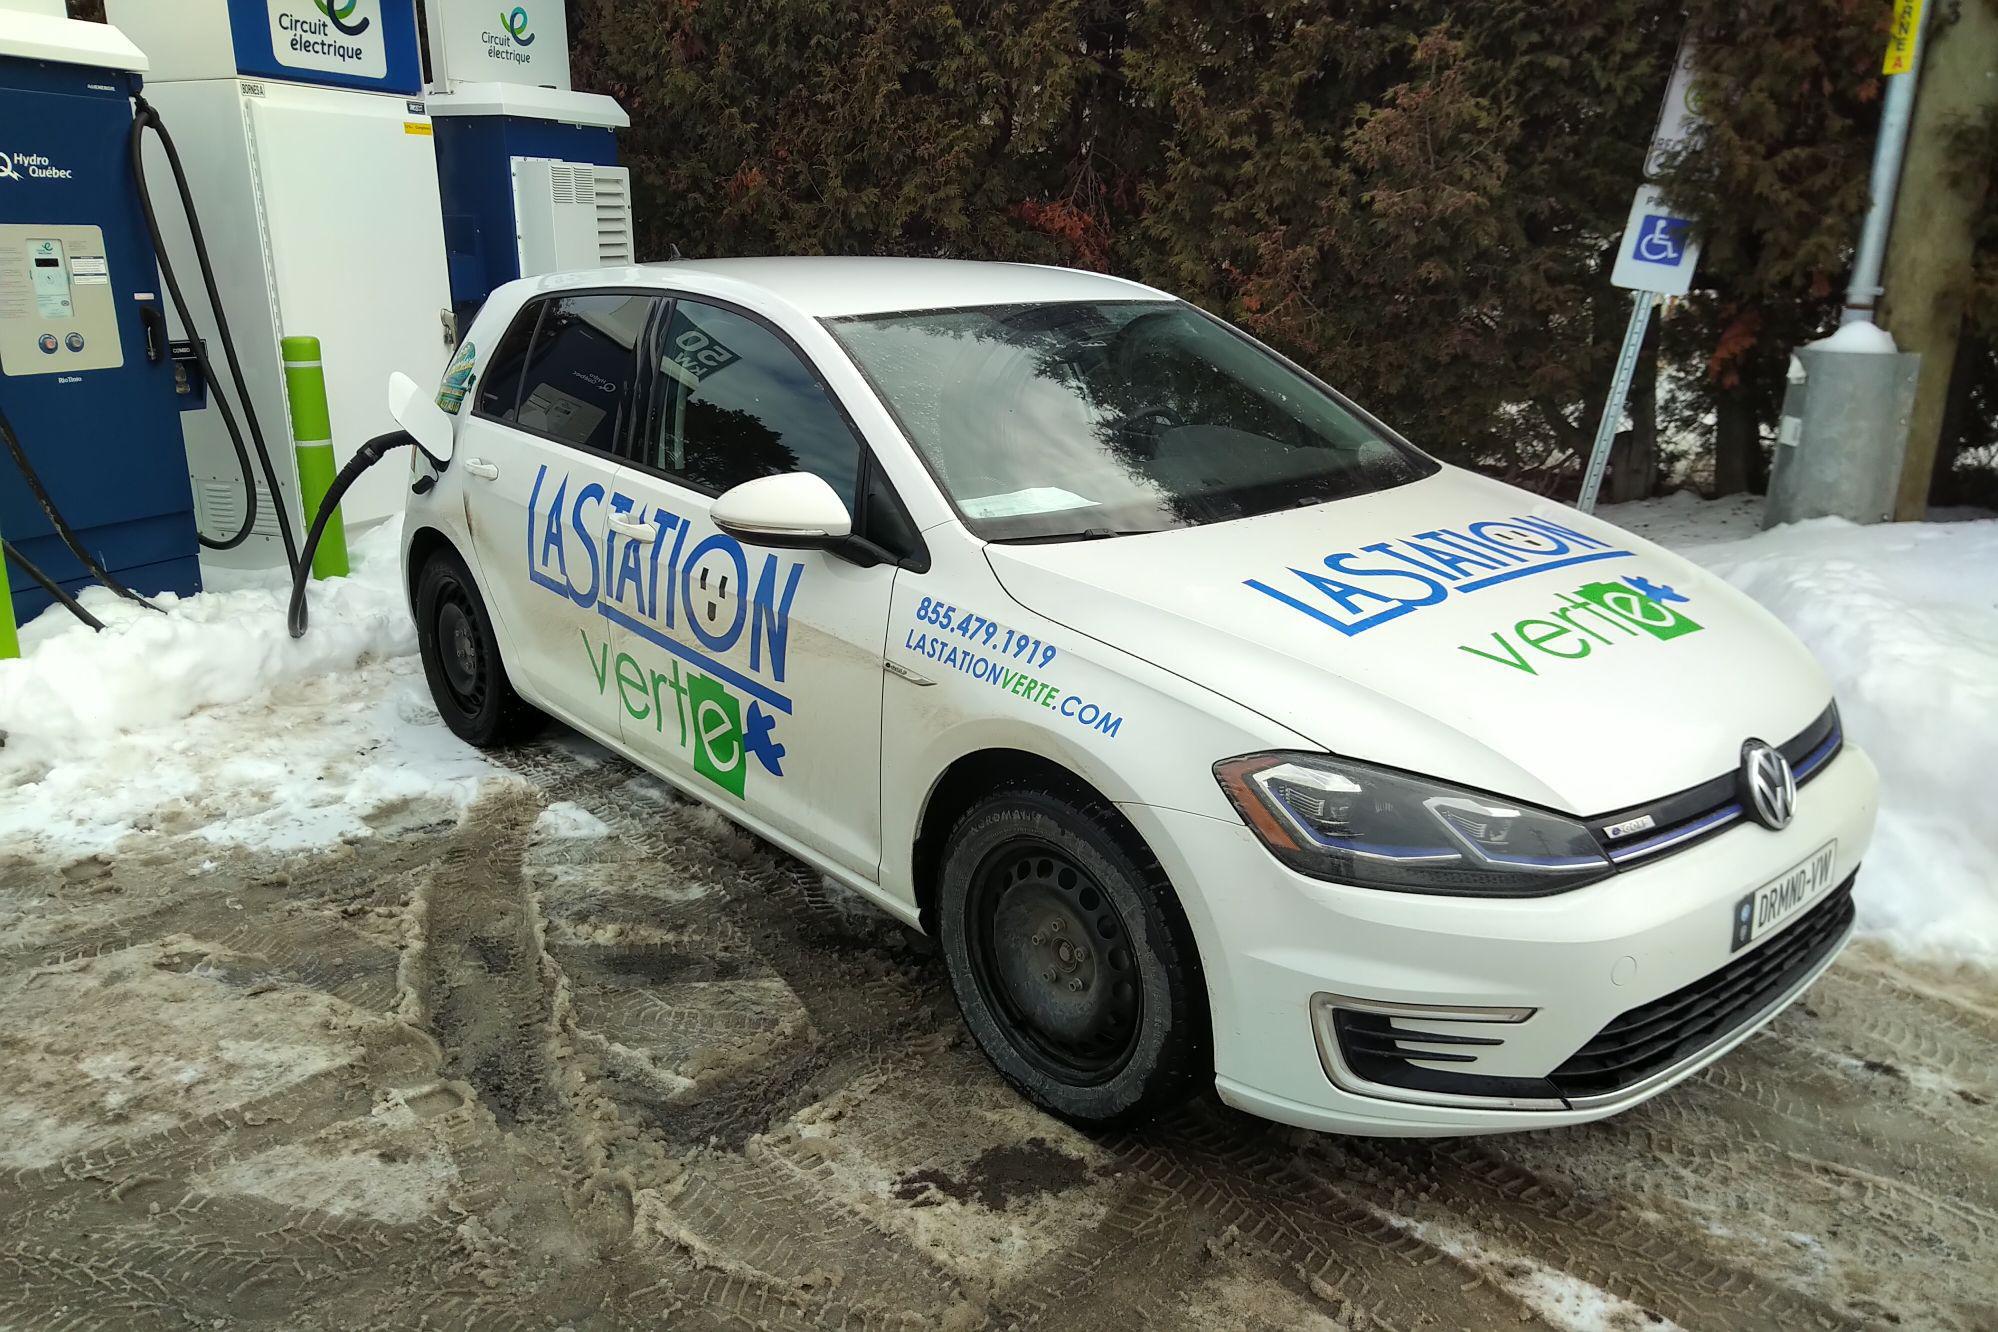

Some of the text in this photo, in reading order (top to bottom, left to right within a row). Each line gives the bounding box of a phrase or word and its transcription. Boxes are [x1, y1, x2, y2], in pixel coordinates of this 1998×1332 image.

[279, 13, 328, 36] Circuit
[290, 33, 363, 62] électrique
[481, 31, 511, 47] Circuit
[488, 45, 531, 65] électrique
[13, 153, 49, 167] Hydro
[29, 166, 72, 179] Québec
[527, 464, 805, 683] LASTATION
[1241, 515, 1612, 637] LASTATION
[916, 597, 1057, 669] 855.479.1919
[1458, 591, 1677, 676] verte
[580, 629, 740, 772] verte
[905, 629, 1124, 738] LASTATIONVERTE.COM
[1758, 849, 1833, 928] DRMND-VW
